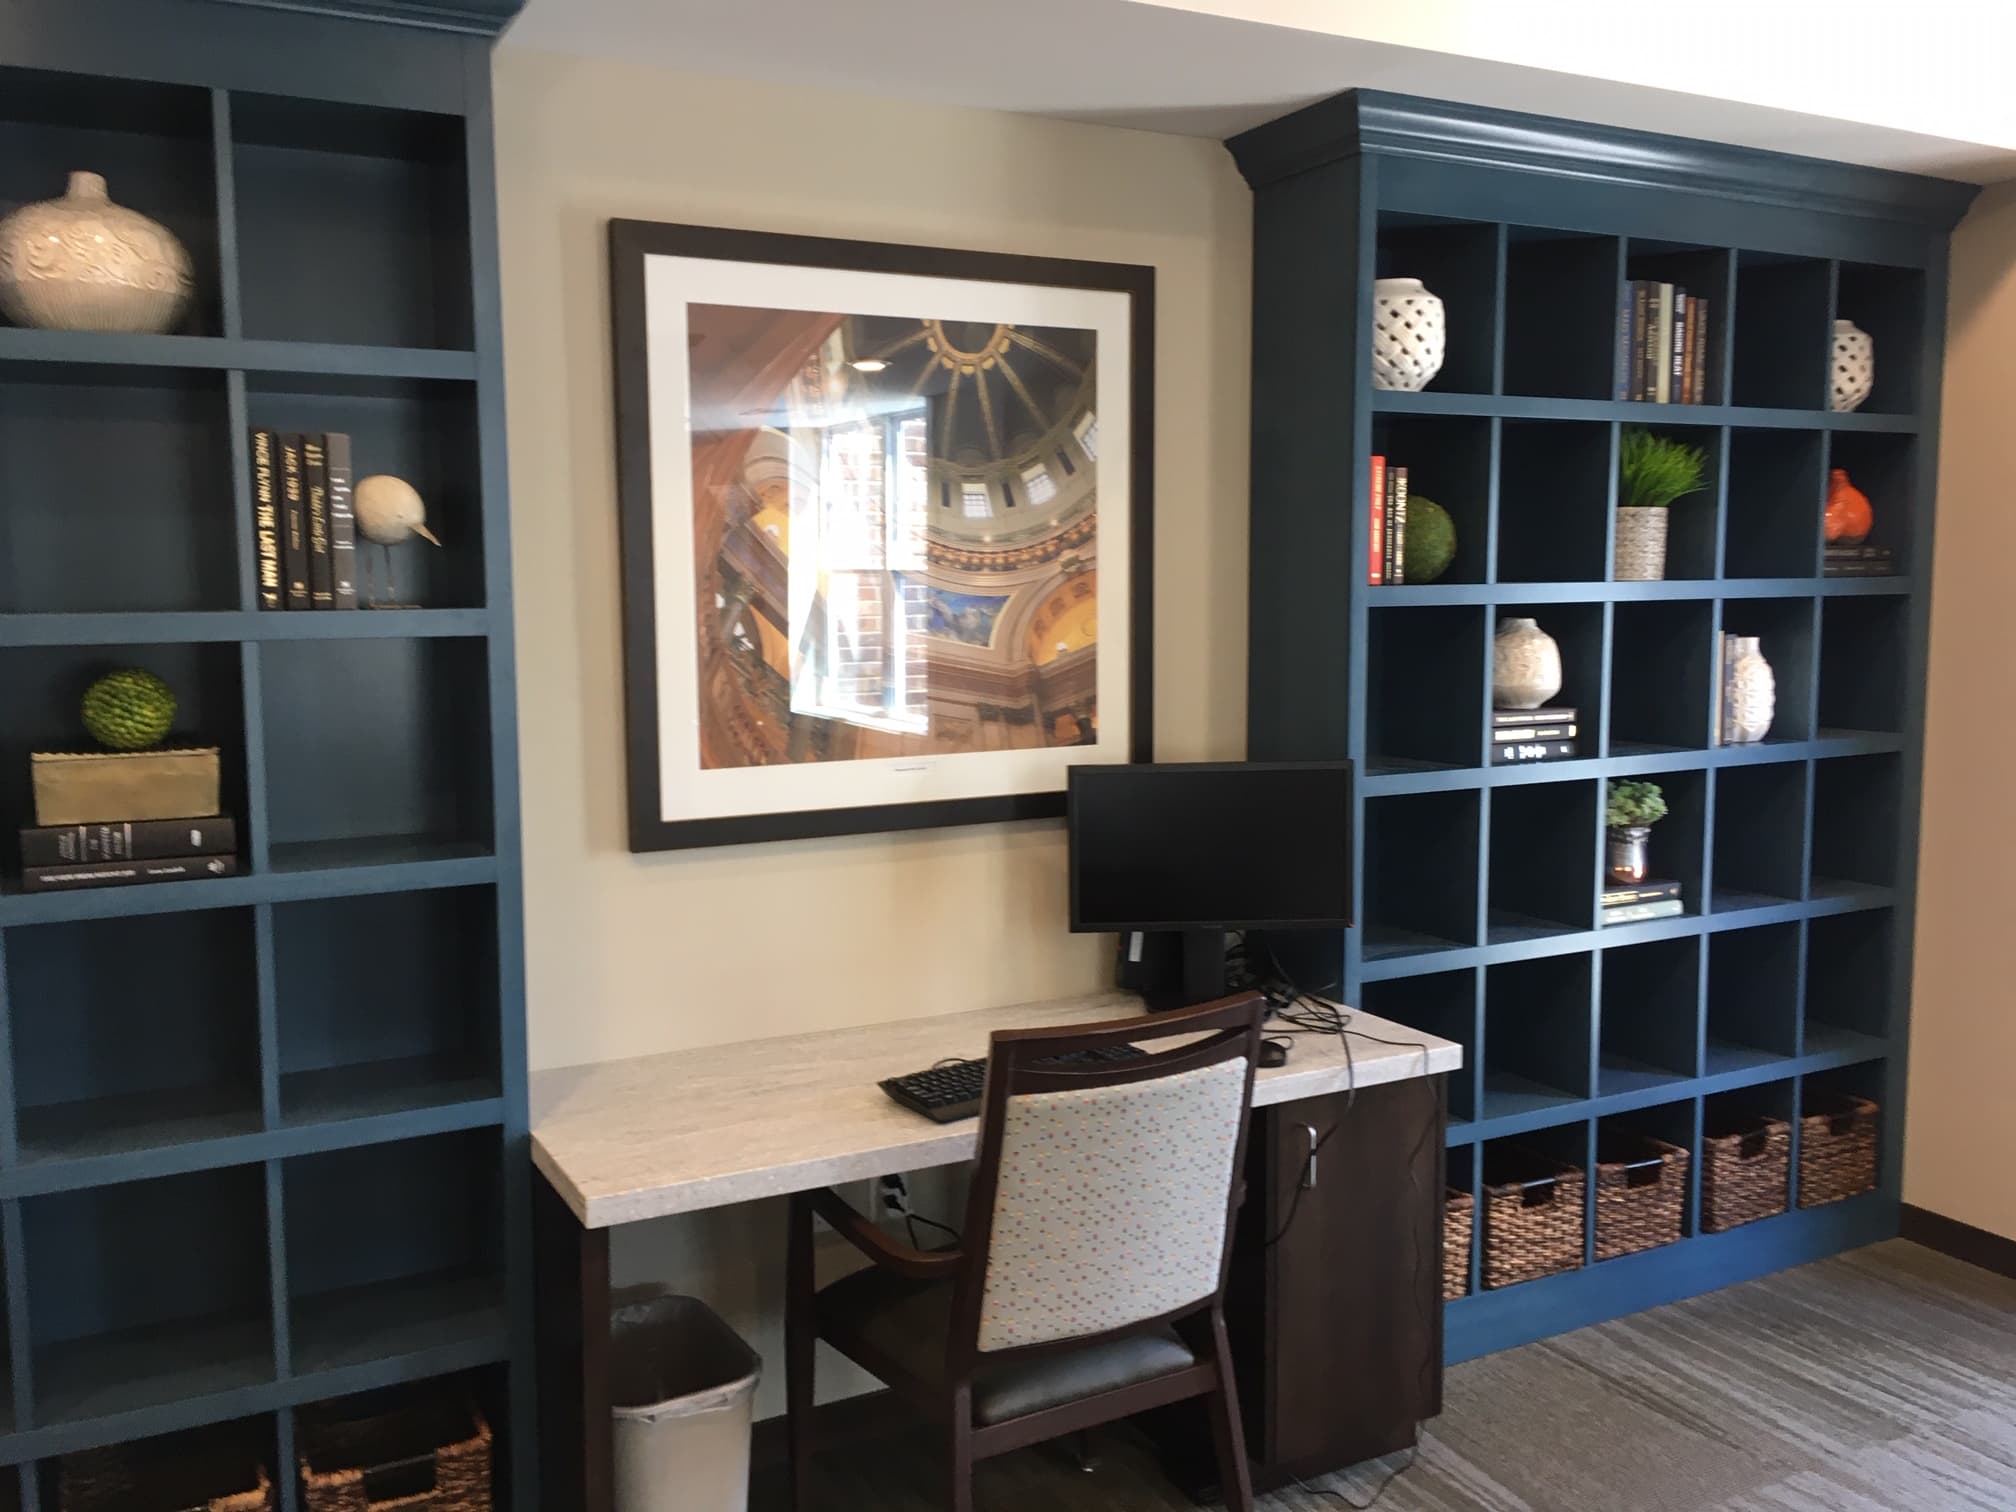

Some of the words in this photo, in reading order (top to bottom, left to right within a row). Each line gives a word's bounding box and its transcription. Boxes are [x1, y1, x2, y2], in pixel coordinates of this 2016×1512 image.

[284, 446, 298, 473] JACK
[257, 467, 271, 503] FLYNN
[1395, 478, 1408, 523] KOONTZ
[257, 505, 275, 529] THE
[258, 530, 277, 559] LAST
[260, 560, 278, 587] MAN
